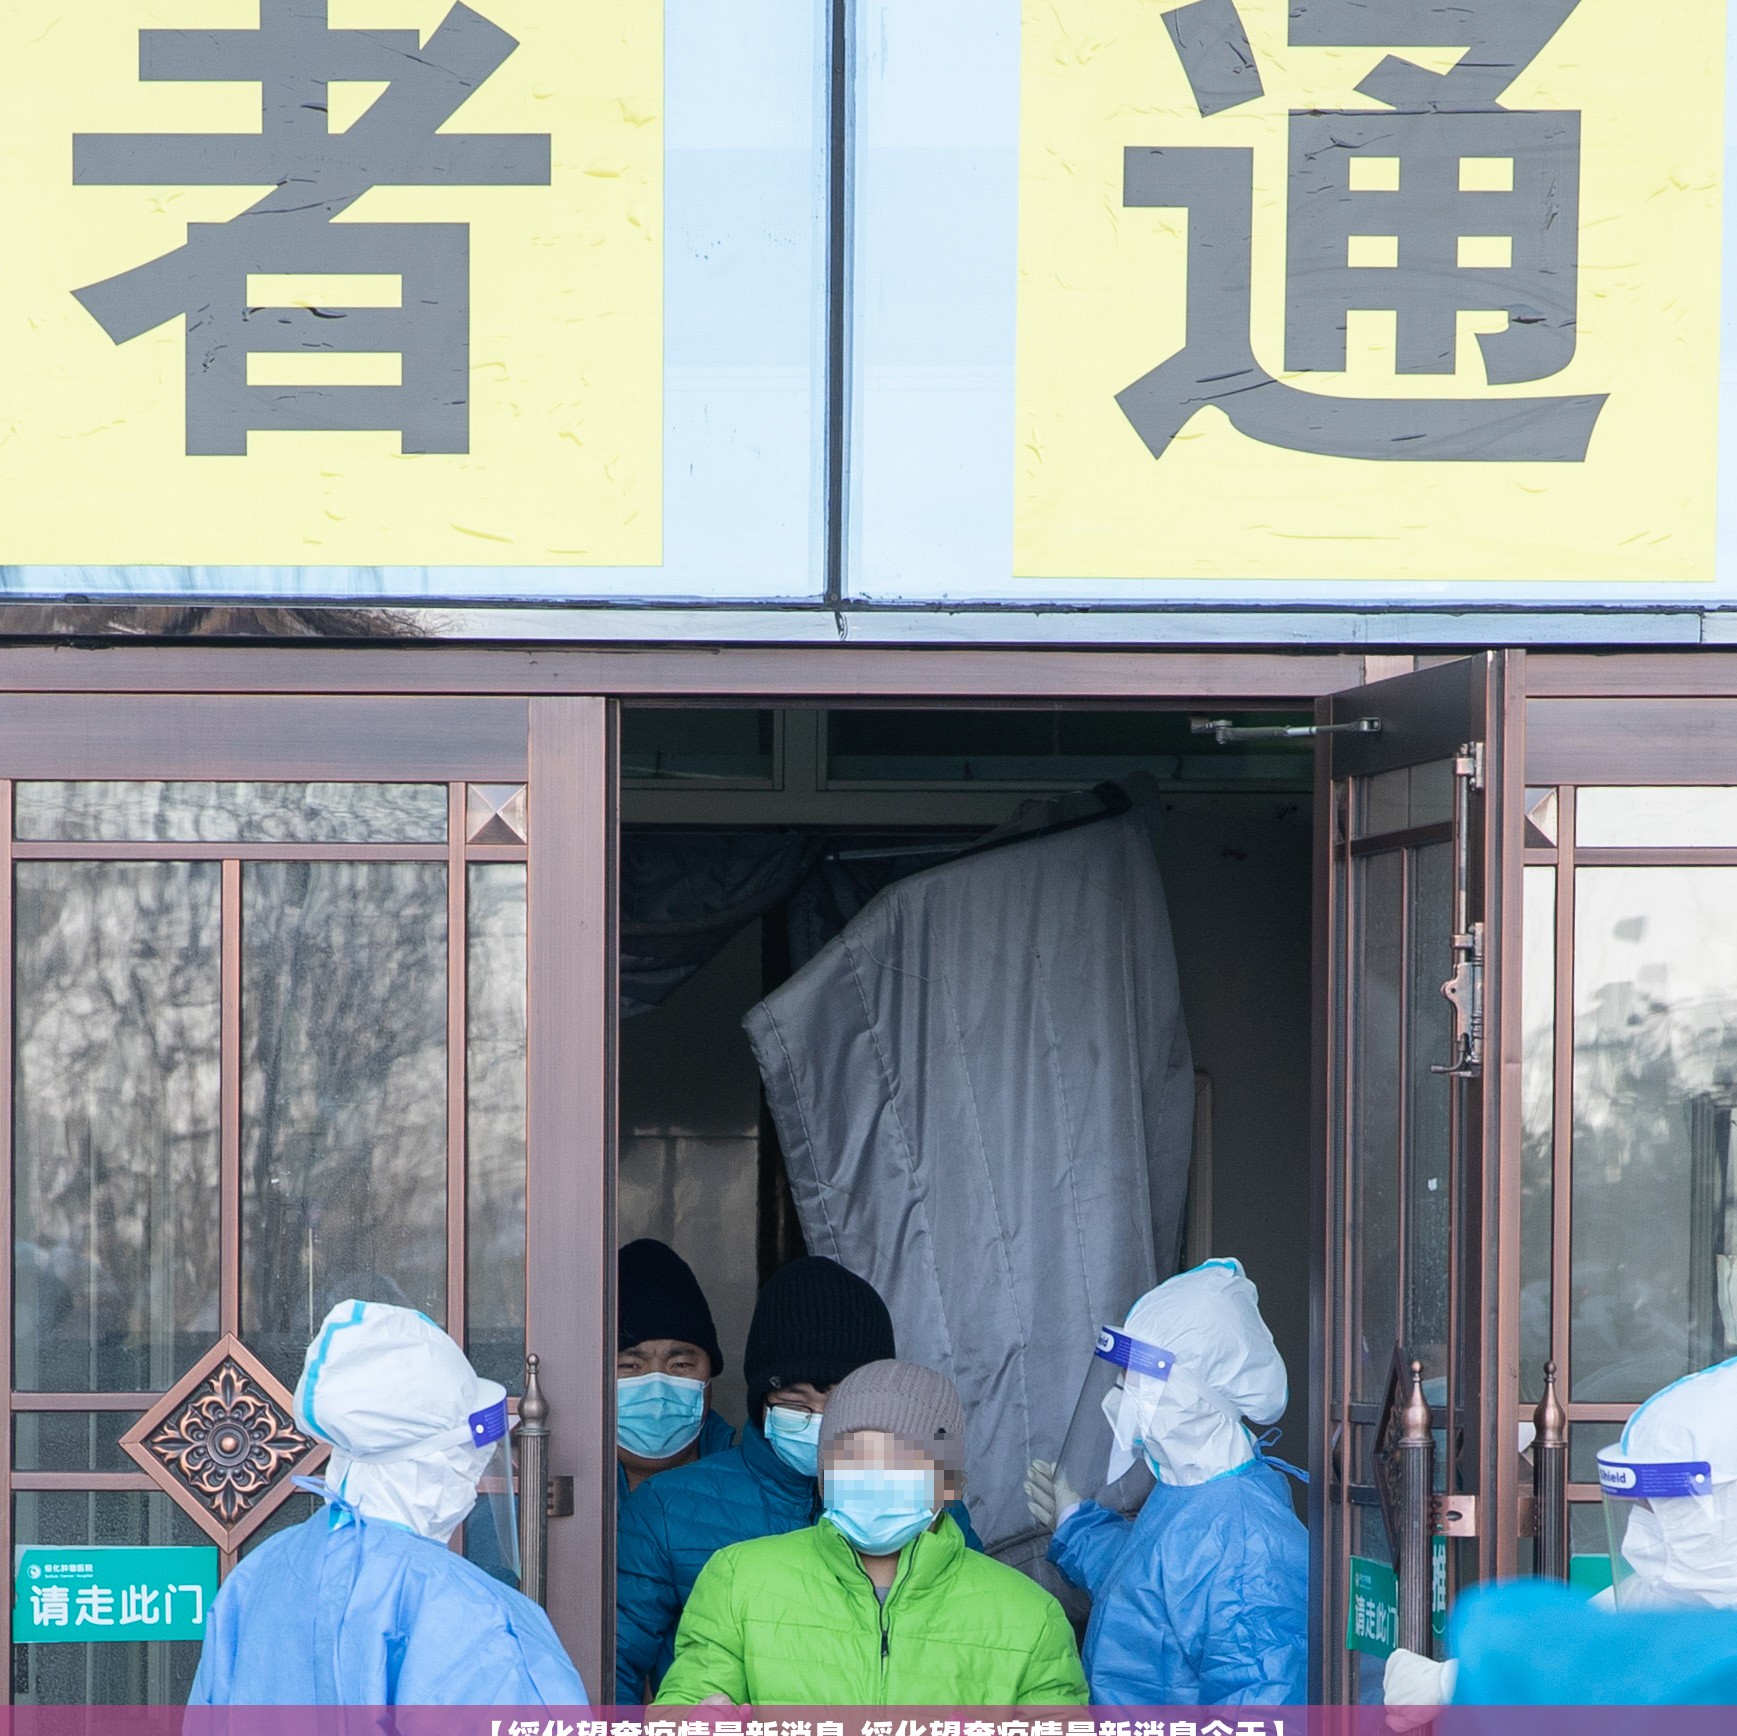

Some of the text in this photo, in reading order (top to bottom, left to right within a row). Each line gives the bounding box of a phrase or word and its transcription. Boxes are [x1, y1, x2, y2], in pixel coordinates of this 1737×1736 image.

[30, 1584, 203, 1627] 请走此门
[1354, 1593, 1399, 1650] 请走此门
